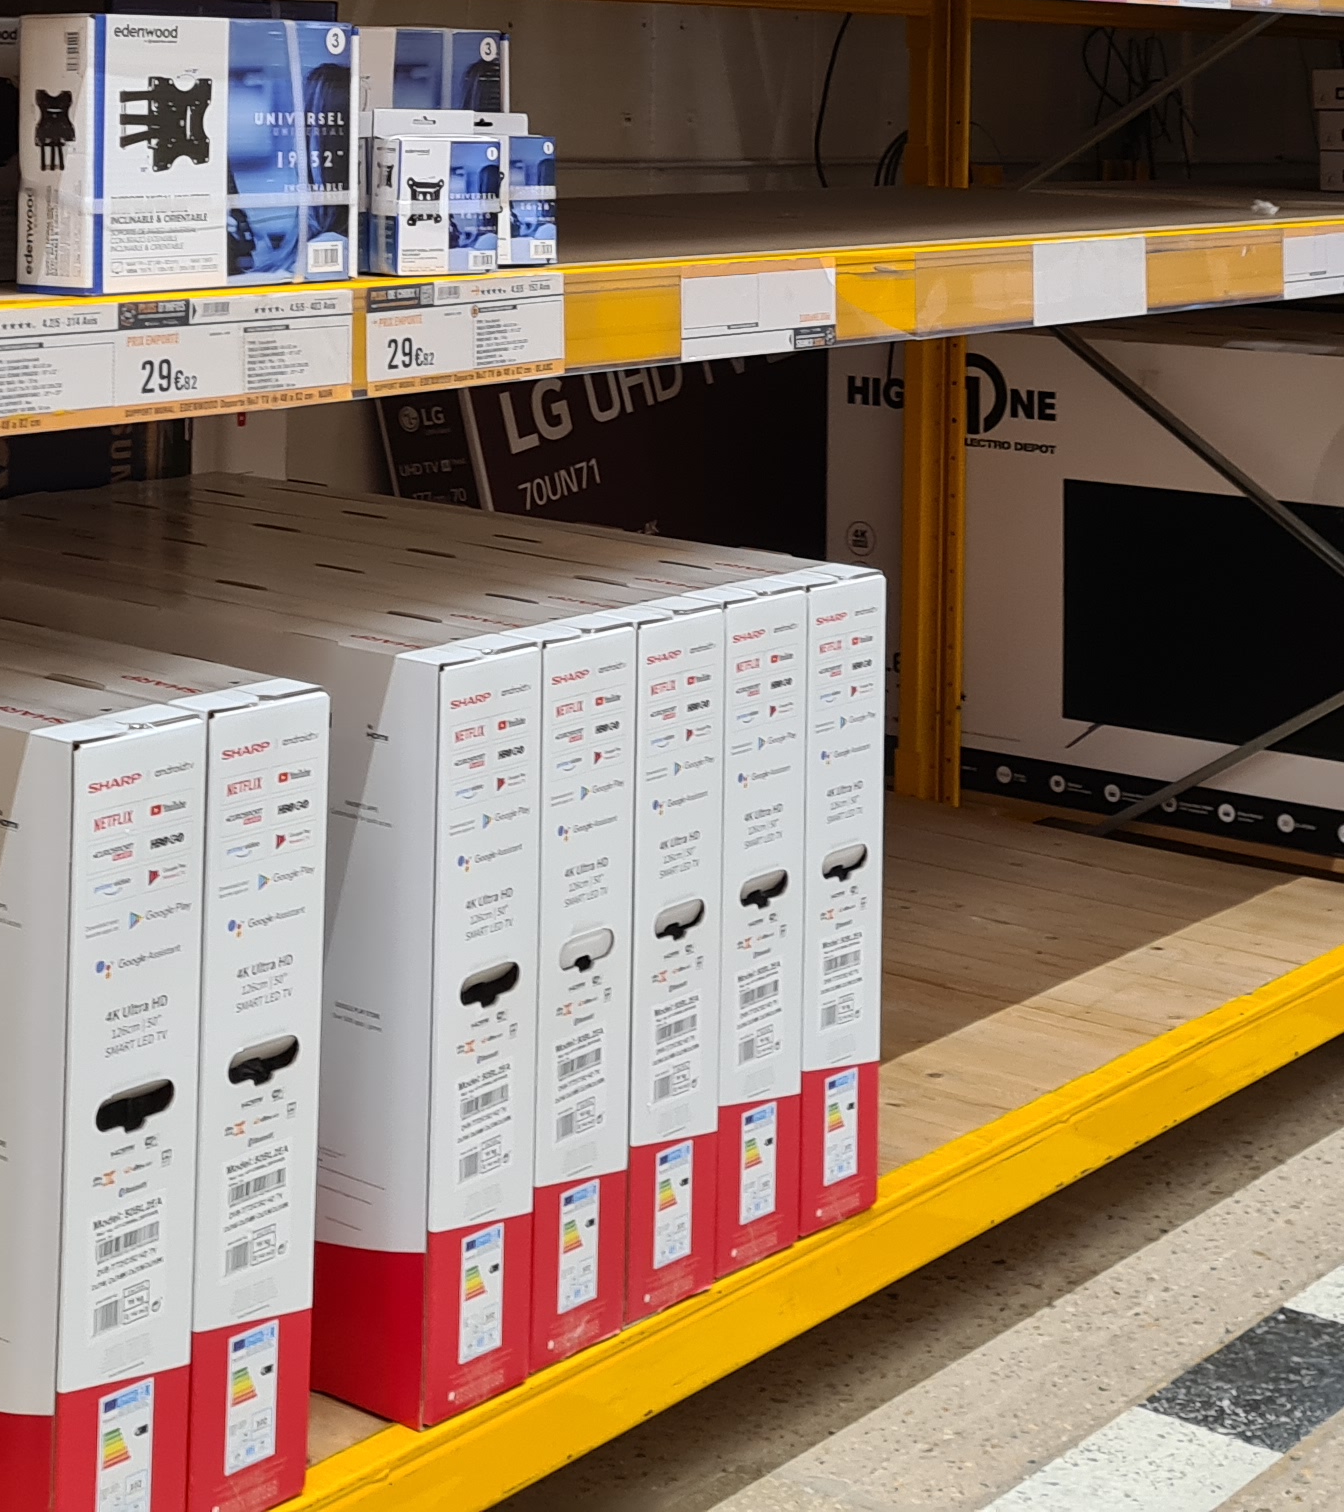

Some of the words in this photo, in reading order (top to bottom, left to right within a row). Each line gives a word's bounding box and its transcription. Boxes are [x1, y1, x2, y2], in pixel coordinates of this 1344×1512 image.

[114, 25, 178, 41] edenwood
[387, 337, 434, 370] 29€82
[141, 358, 198, 394] 29€82
[421, 406, 445, 425] LG
[500, 379, 573, 454] LG
[1013, 439, 1056, 454] DEPOT
[518, 458, 602, 510] 70UN71
[646, 649, 682, 666] SHARP
[552, 669, 590, 686] SHARP
[450, 691, 491, 710] SHARP
[221, 740, 271, 761] SHARP
[88, 772, 142, 794] SHARP
[227, 777, 263, 797] NETFLIX
[94, 810, 133, 832] NETFLIX
